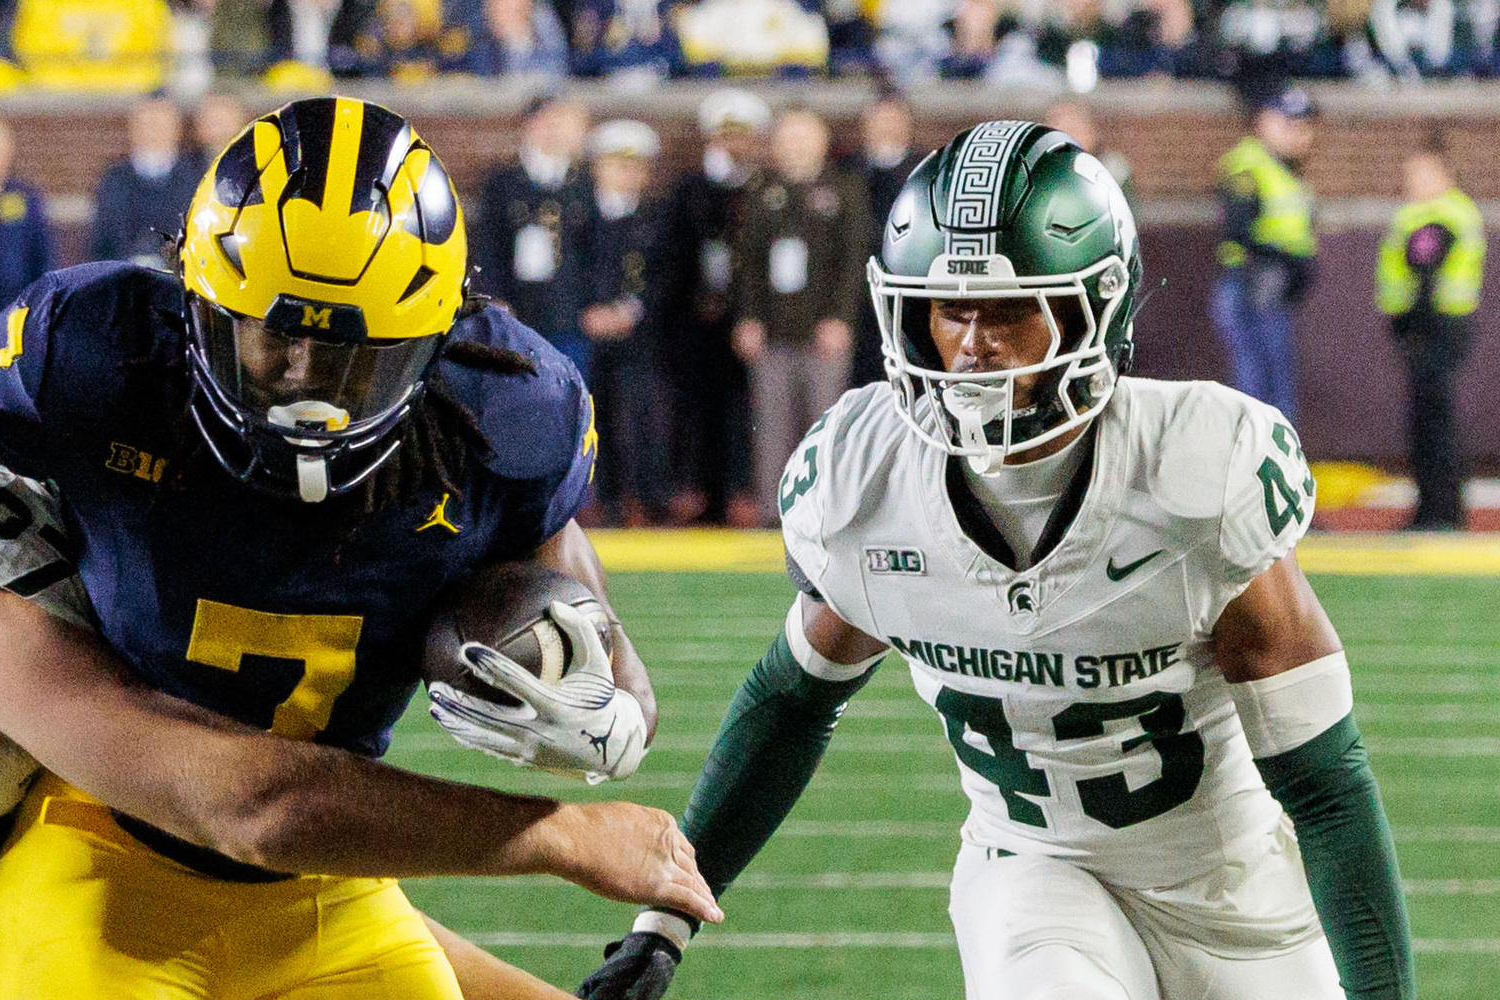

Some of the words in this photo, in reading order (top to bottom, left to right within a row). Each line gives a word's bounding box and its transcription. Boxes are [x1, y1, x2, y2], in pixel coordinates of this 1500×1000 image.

[947, 259, 990, 275] STATE
[301, 305, 332, 330] M
[186, 597, 364, 743] 7
[887, 635, 1066, 688] MICHIGAN
[1074, 641, 1184, 689] STATE
[934, 684, 1206, 830] 43
